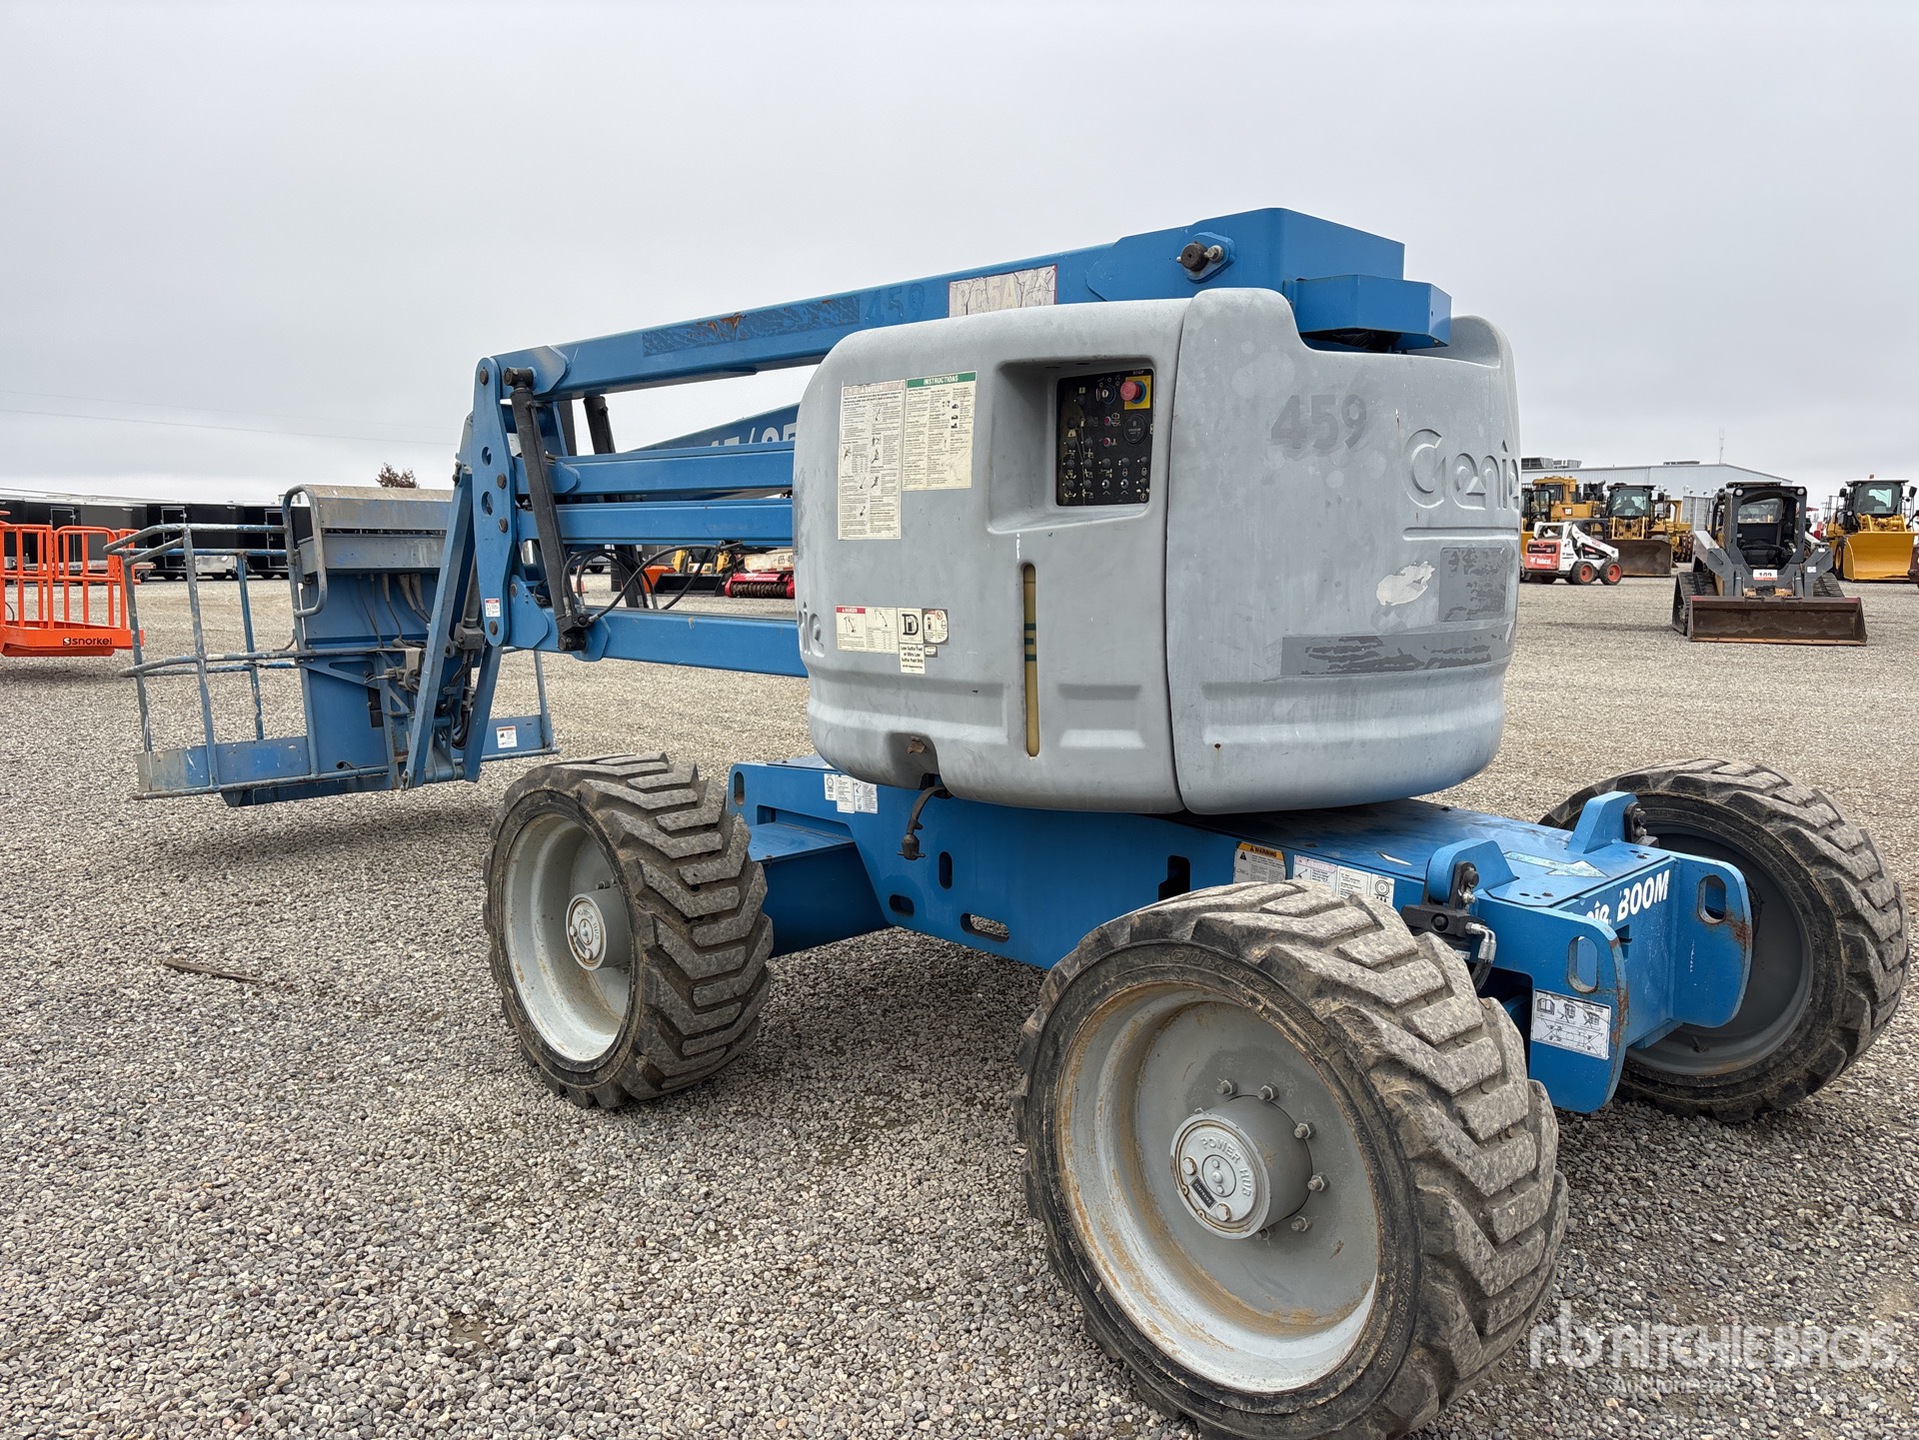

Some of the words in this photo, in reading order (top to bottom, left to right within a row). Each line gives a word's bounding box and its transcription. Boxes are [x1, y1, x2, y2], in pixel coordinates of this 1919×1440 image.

[923, 374, 959, 386] INSTRUCTIONS
[1270, 394, 1368, 451] 459
[71, 636, 113, 646] snorkel
[1616, 869, 1670, 923] BOOM
[1200, 1135, 1241, 1164] POWER
[1240, 1167, 1252, 1197] HUB
